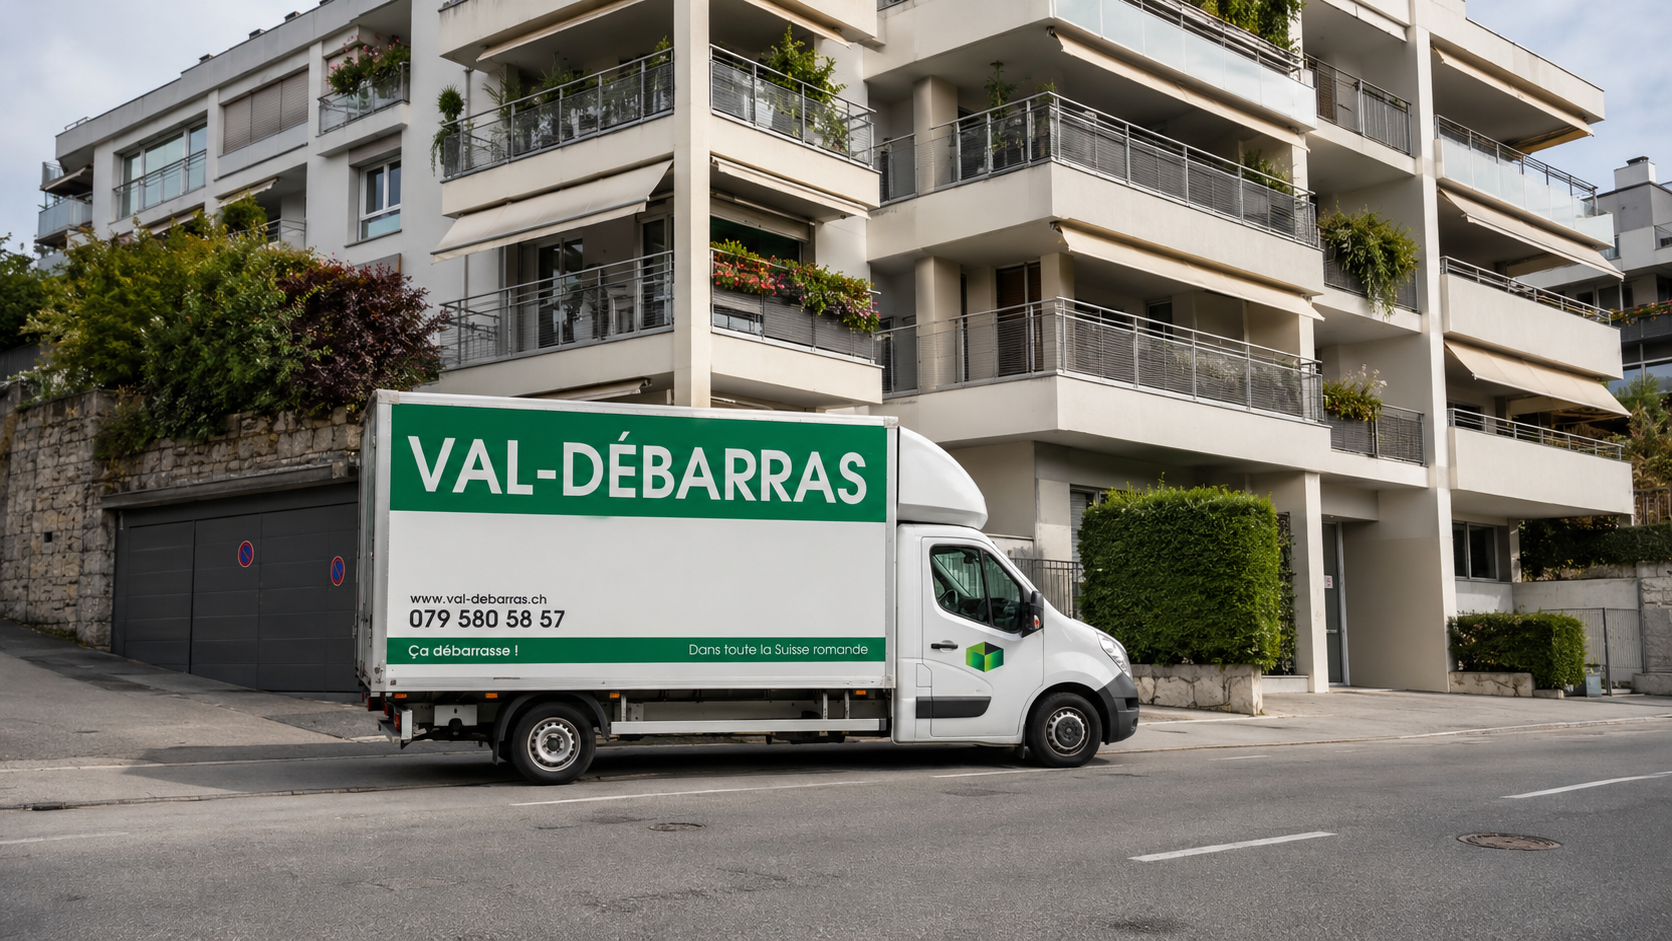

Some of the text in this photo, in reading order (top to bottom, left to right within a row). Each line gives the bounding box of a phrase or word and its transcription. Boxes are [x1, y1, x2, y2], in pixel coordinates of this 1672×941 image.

[408, 431, 868, 505] VAL-DÉBARRAS
[410, 593, 547, 605] www.val-debarras.ch
[409, 609, 566, 629] 079 580 58 57
[408, 644, 429, 659] Ça
[433, 644, 511, 657] débarrasse
[688, 643, 869, 656] Dans toute la Suisse romande
